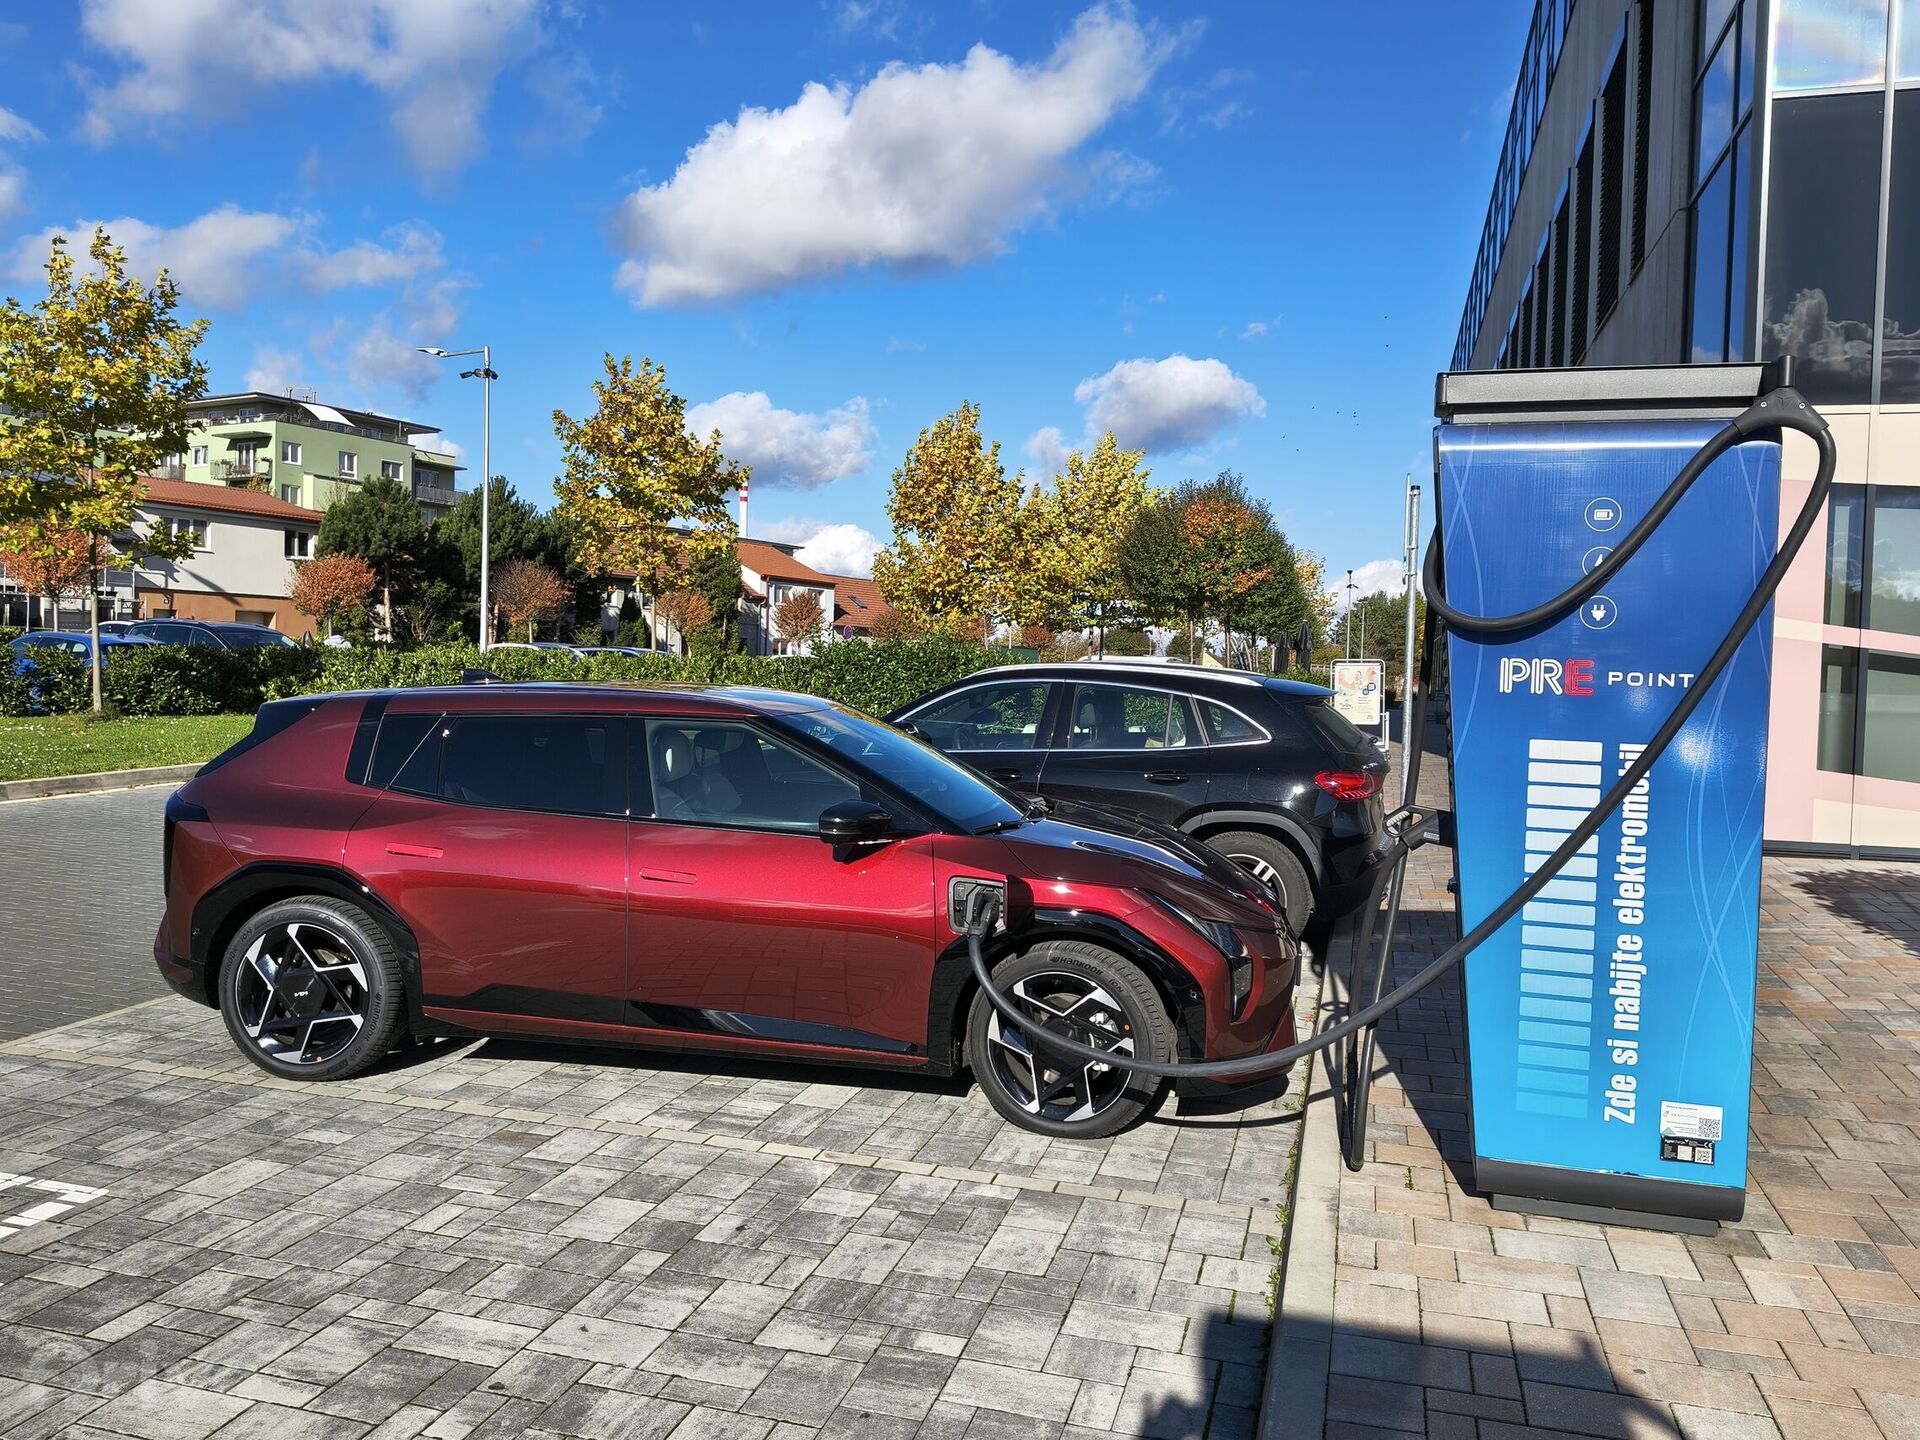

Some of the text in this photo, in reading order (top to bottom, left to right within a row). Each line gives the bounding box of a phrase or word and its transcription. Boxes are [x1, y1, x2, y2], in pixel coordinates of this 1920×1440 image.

[1499, 657, 1695, 696] PRE POINT
[1608, 933, 1648, 1031] nabijte
[1606, 1038, 1639, 1065] si
[1604, 1073, 1637, 1125] Zde
